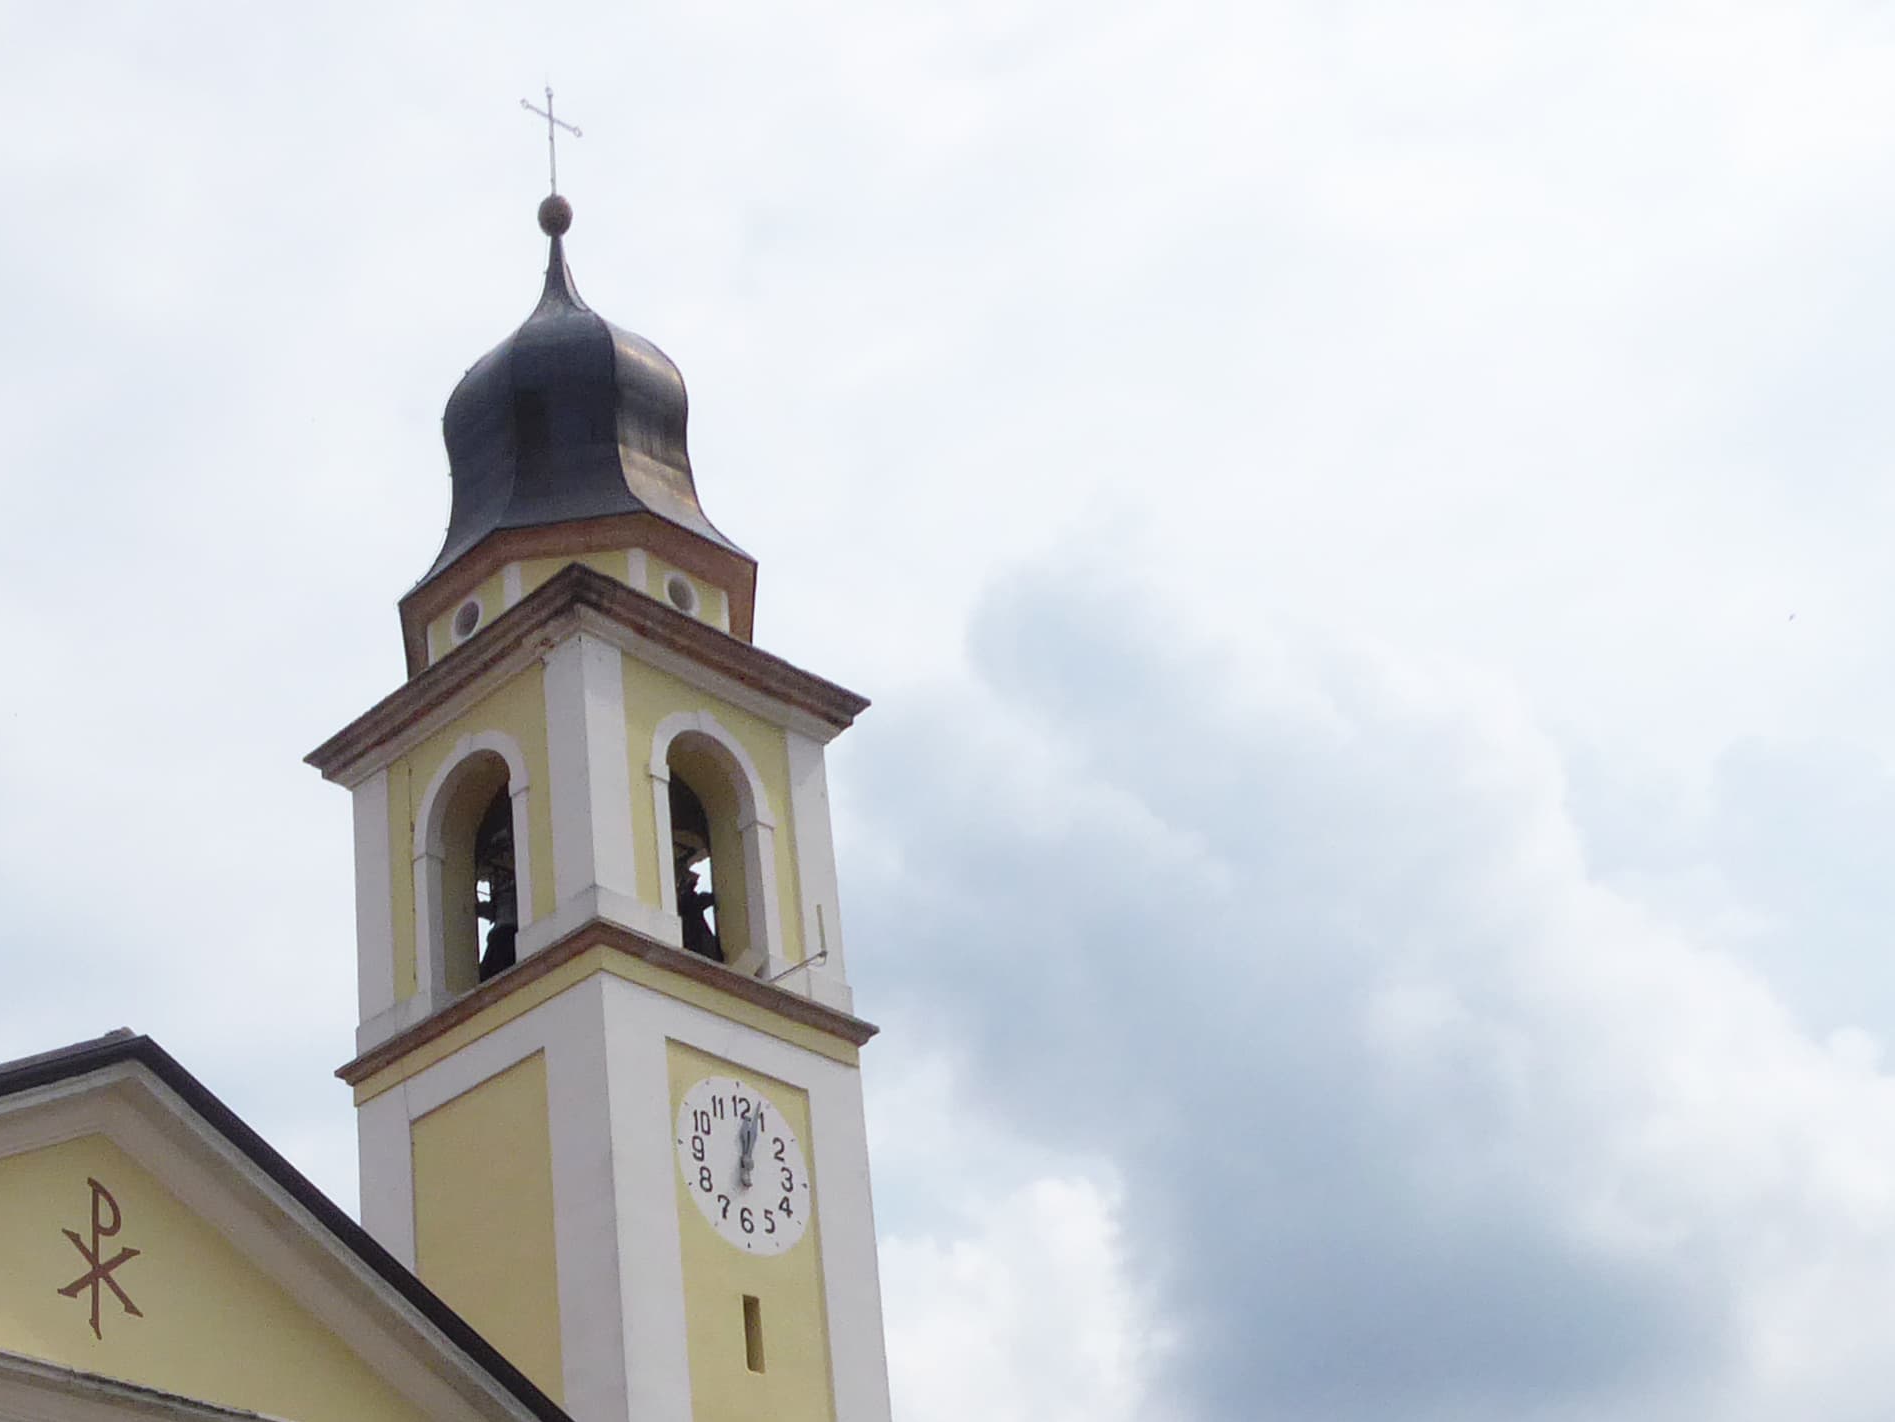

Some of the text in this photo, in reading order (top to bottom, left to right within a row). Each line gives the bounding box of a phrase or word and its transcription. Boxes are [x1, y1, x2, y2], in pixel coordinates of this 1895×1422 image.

[711, 1095, 725, 1120] 11
[732, 1094, 751, 1122] 12
[693, 1109, 711, 1136] 10
[758, 1112, 765, 1132] 1
[692, 1135, 705, 1162] 9
[773, 1137, 786, 1162] 2
[699, 1166, 713, 1193] 8
[780, 1167, 794, 1193] 3
[717, 1194, 731, 1220] 7
[779, 1196, 794, 1218] 4
[740, 1207, 755, 1234] 6
[764, 1209, 776, 1234] 5
